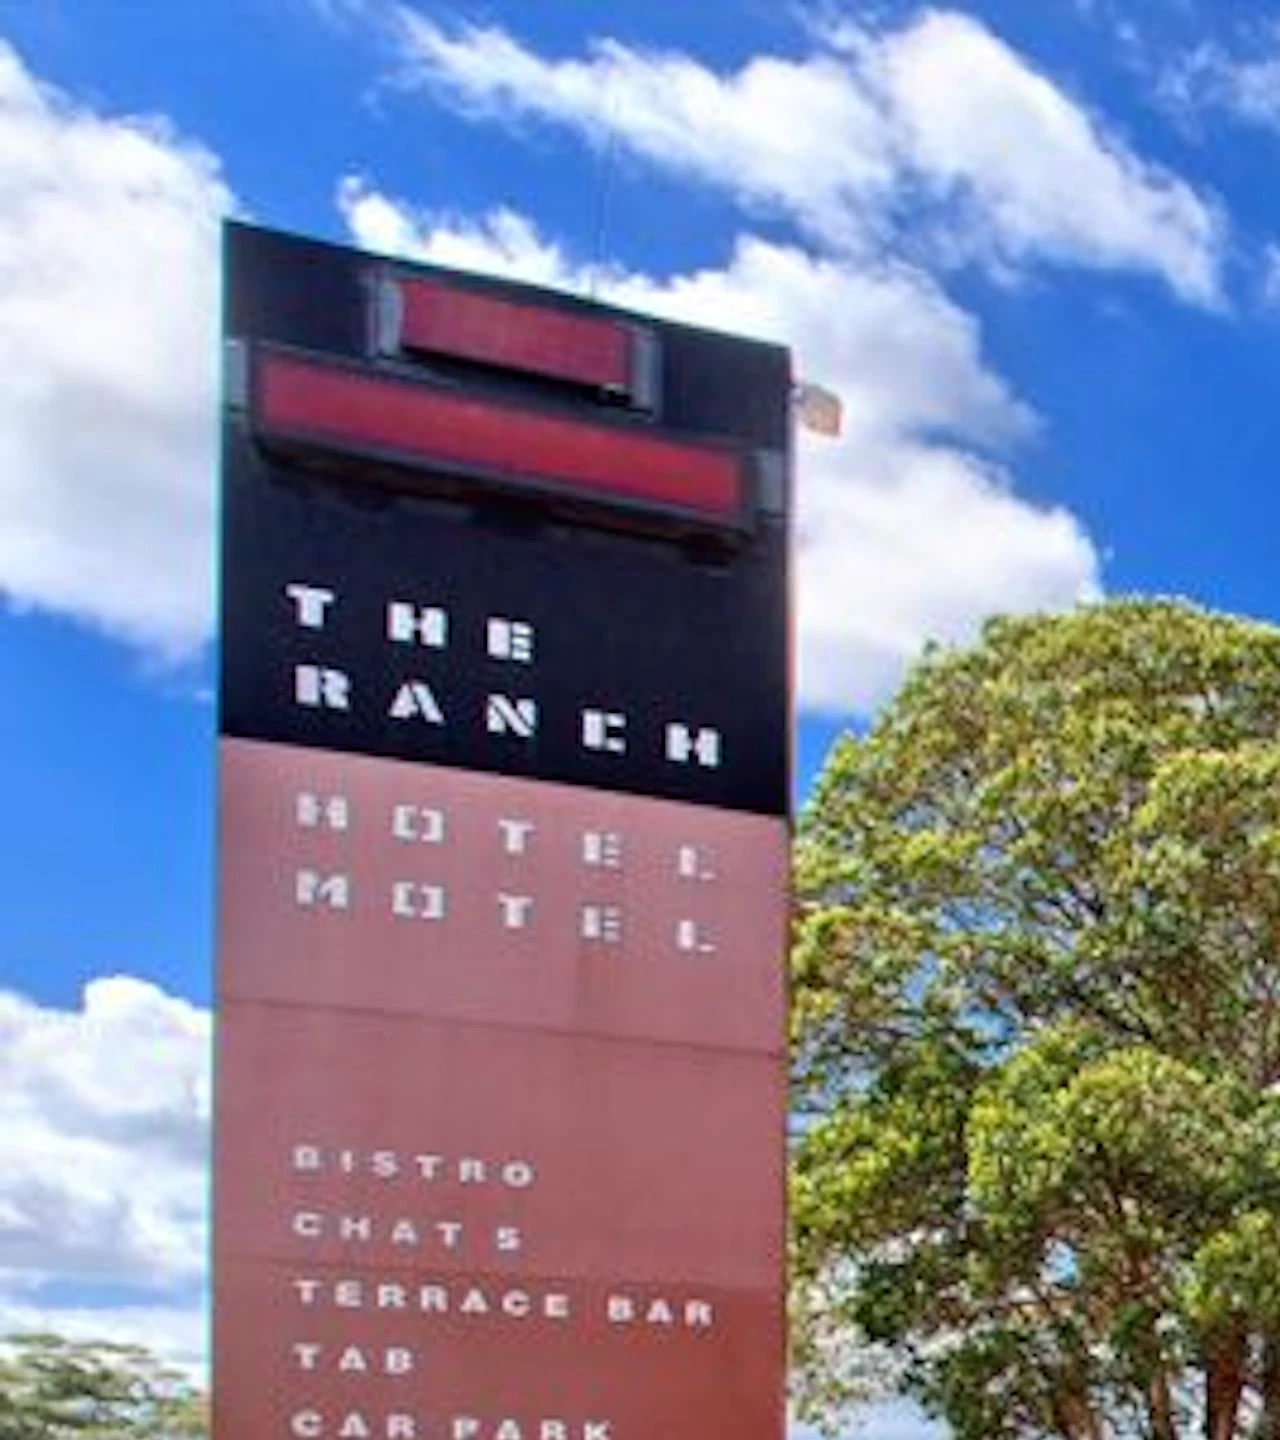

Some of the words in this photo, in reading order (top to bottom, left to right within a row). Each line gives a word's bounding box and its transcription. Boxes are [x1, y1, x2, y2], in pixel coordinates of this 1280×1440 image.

[287, 584, 533, 662] THE
[295, 665, 719, 767] RANCH
[295, 791, 716, 880] HOTEL
[296, 868, 716, 953] MOTEL
[293, 1146, 532, 1185] BISTRO
[293, 1279, 570, 1317] TERRACE
[606, 1297, 713, 1326] BAR
[293, 1344, 414, 1374] TAB
[290, 1410, 416, 1440] CAR
